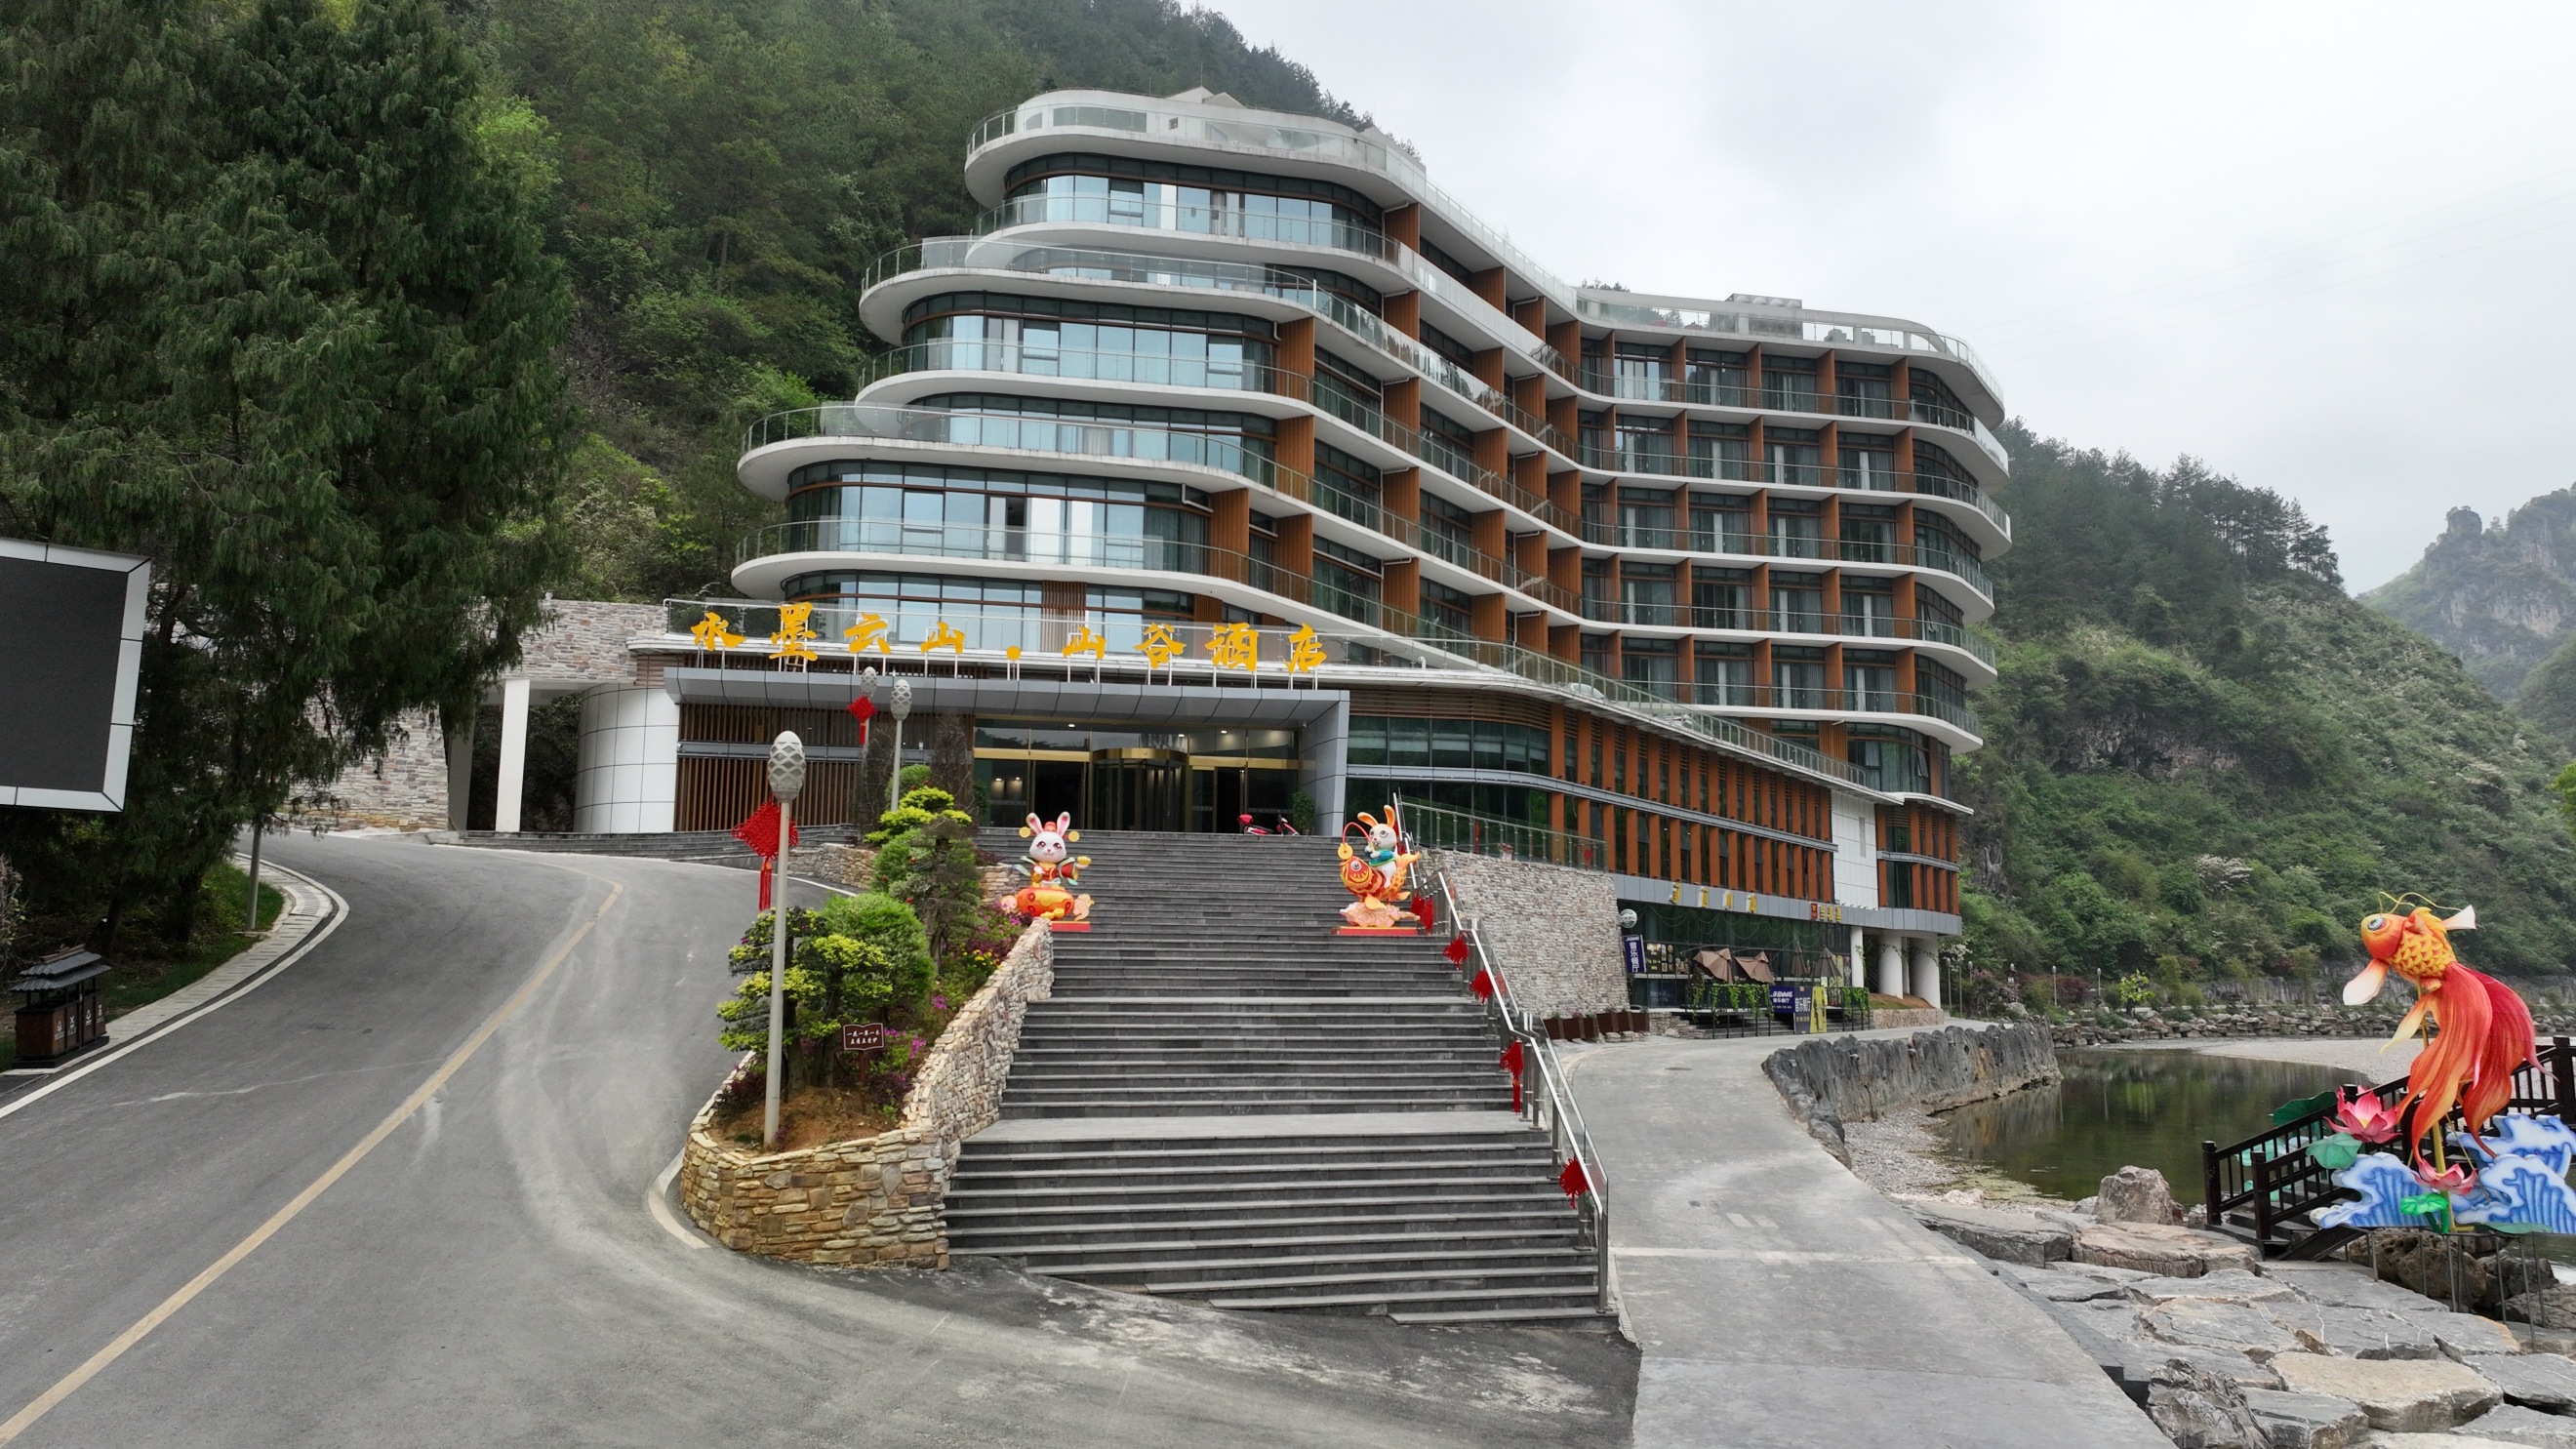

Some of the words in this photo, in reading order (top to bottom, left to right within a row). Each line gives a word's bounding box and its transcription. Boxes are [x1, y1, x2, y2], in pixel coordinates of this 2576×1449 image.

[1630, 942, 1640, 973] 音乐餐厅
[1794, 996, 1811, 1013] 音乐餐厅
